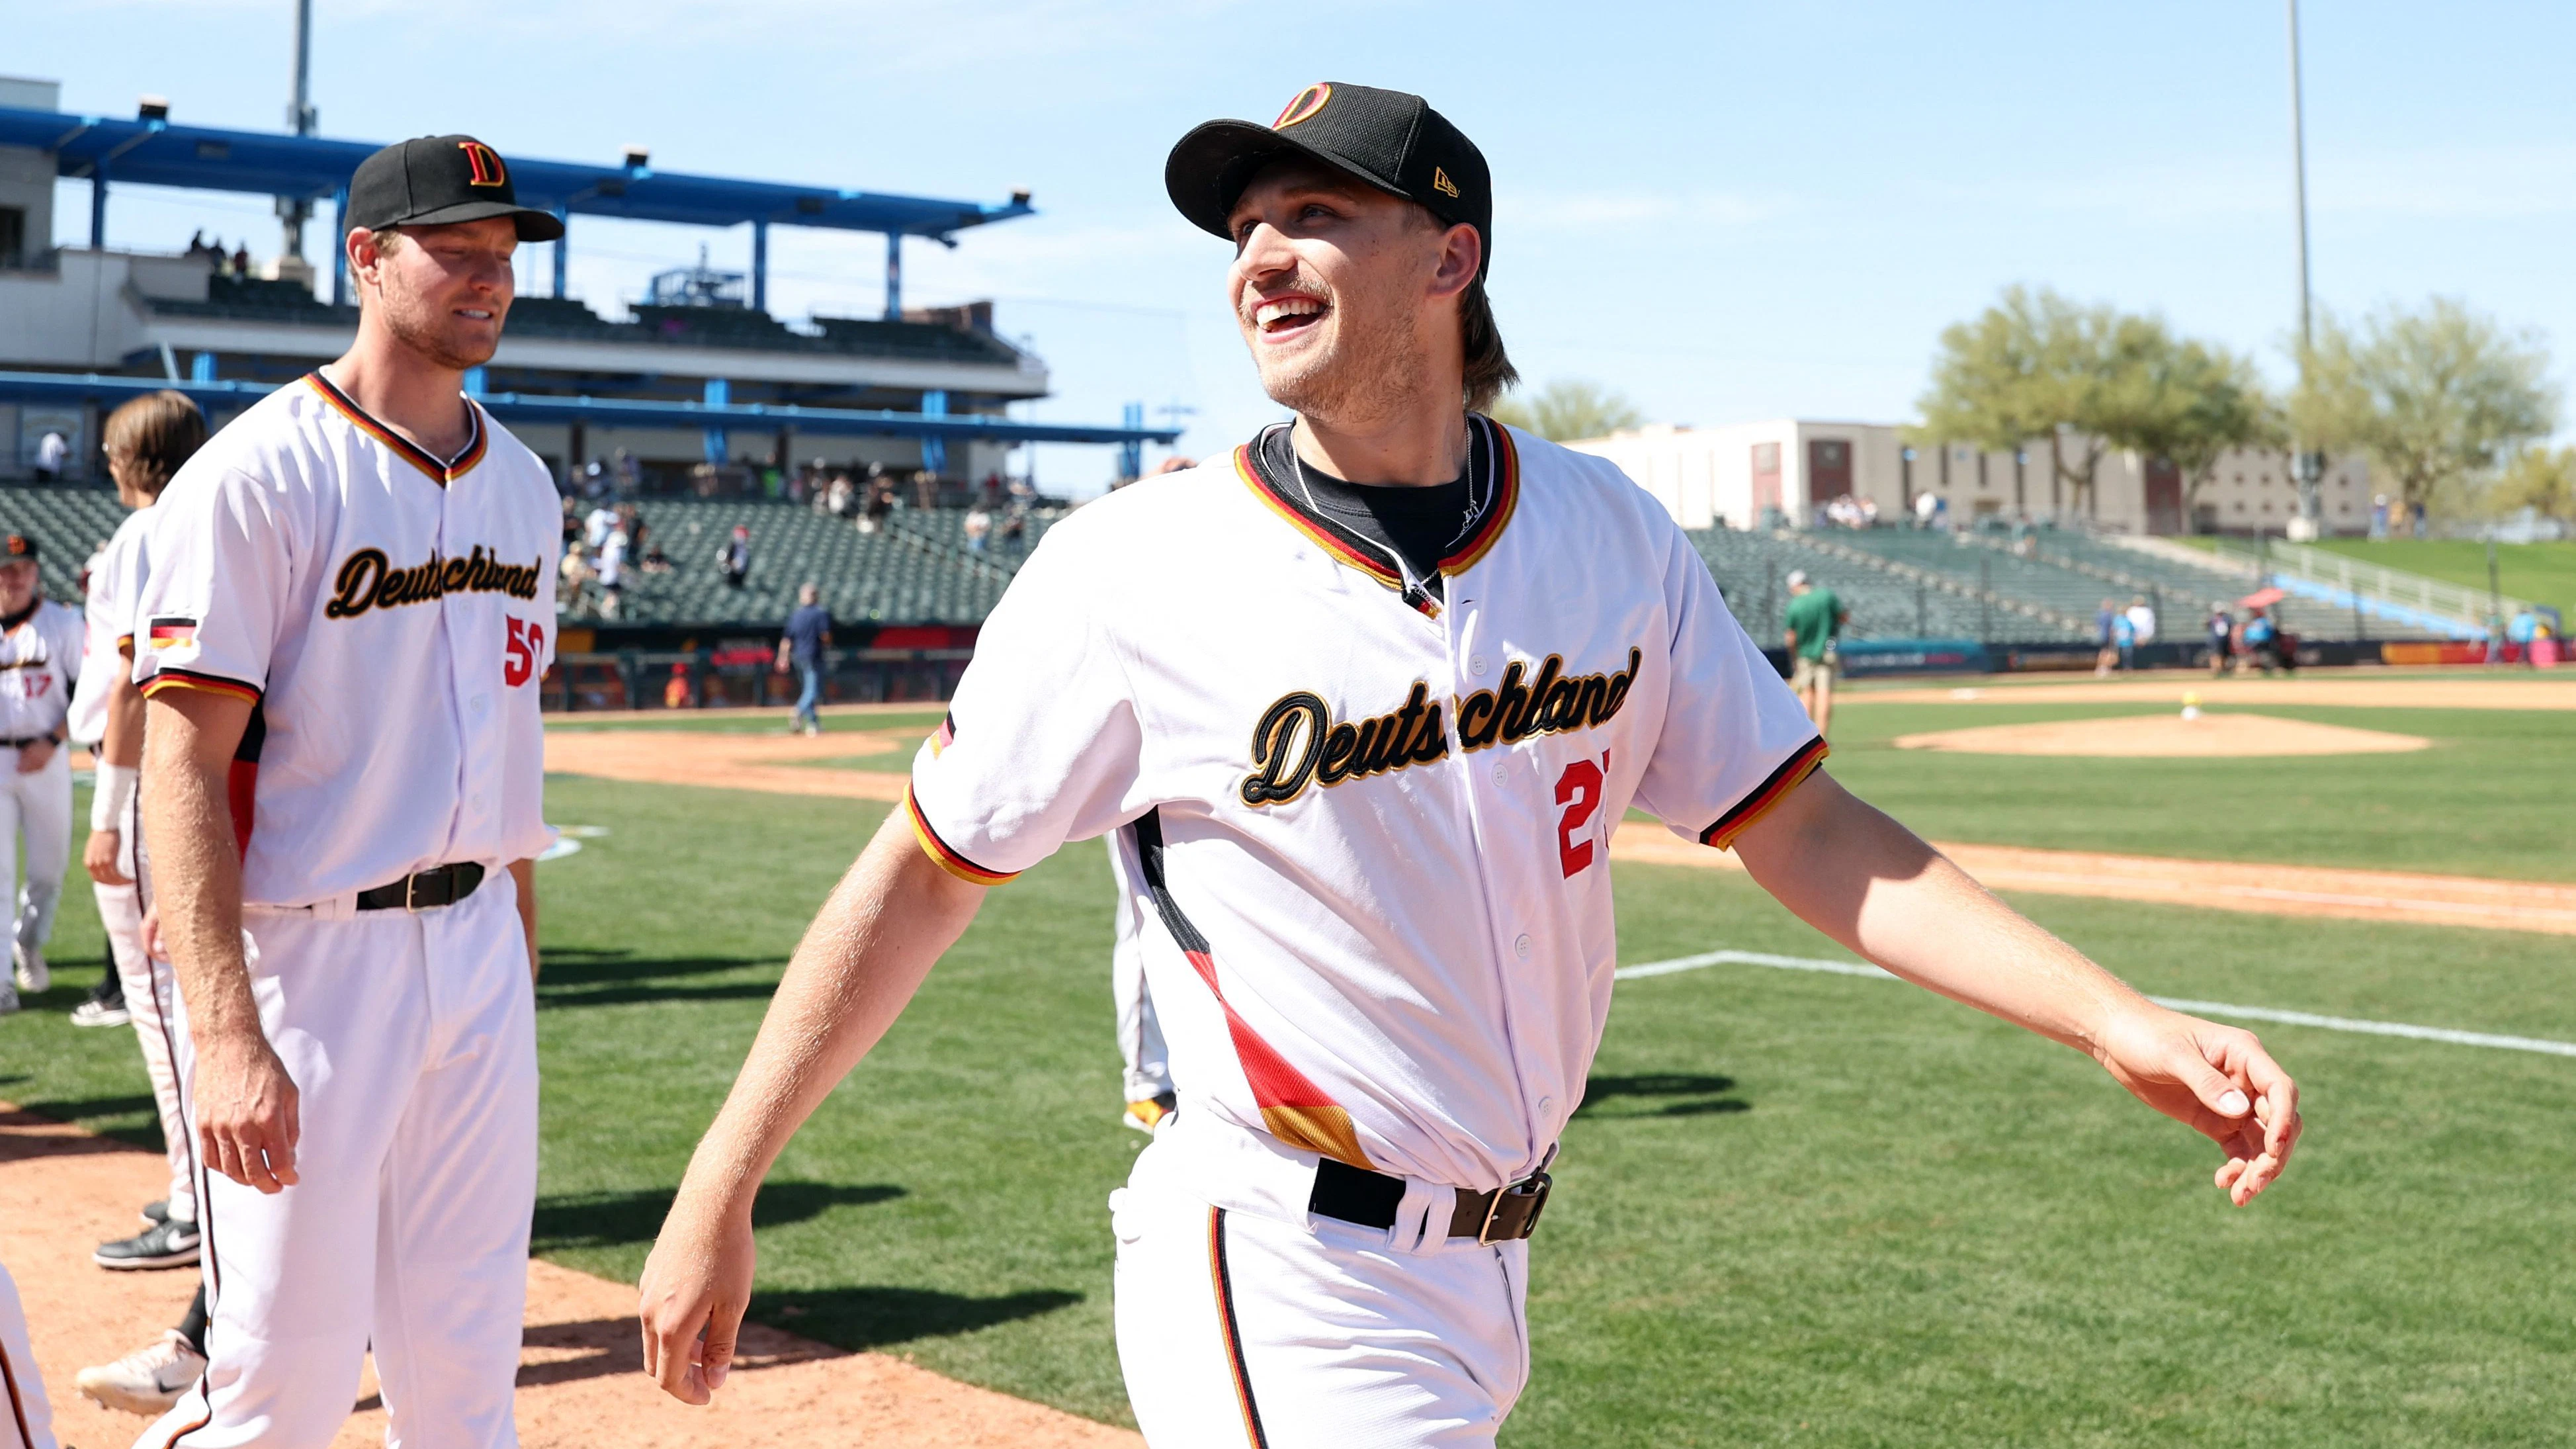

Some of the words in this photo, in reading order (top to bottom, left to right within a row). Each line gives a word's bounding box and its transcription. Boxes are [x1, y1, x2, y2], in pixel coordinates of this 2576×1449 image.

[458, 141, 505, 187] D
[1240, 646, 1643, 808] Deutschland
[1555, 747, 1611, 880] 2
